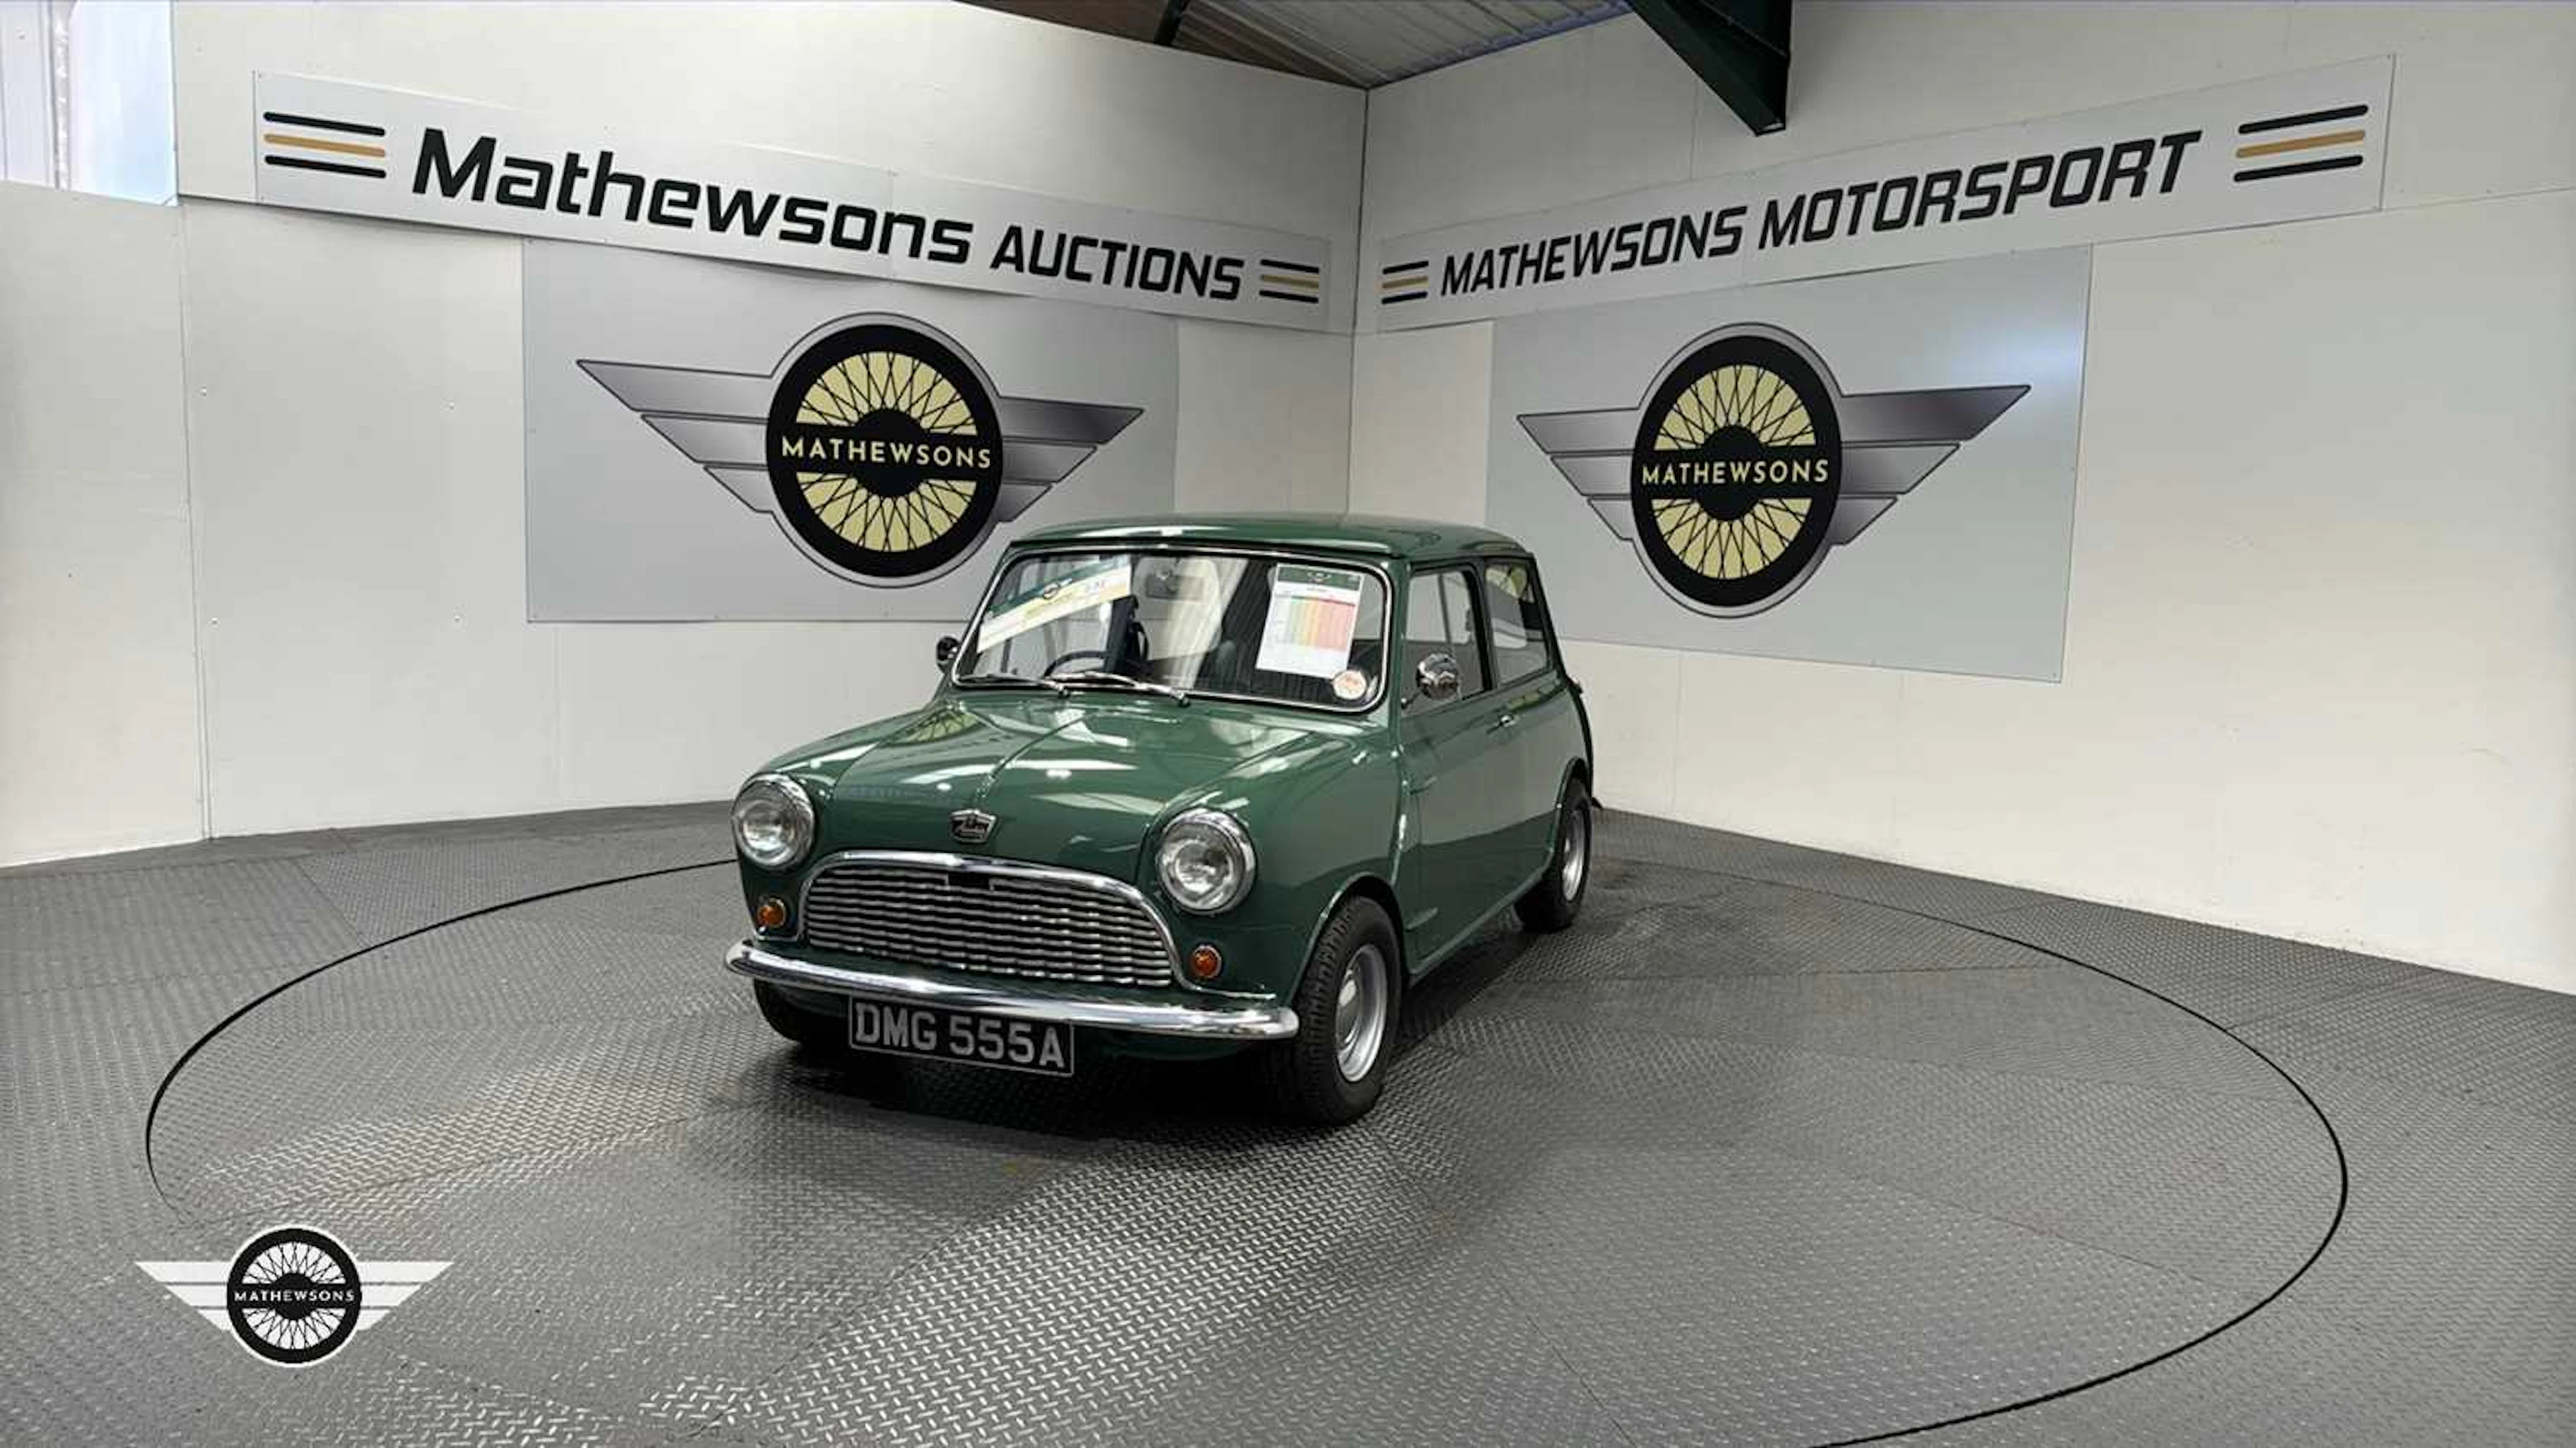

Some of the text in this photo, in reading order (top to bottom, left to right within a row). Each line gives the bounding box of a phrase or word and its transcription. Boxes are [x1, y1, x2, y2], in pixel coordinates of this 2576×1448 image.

[412, 127, 1245, 301] Mathewsons AUCTIONS
[1440, 130, 2203, 297] MATHEWSONS MOTORSPORT
[781, 435, 991, 469] MATHEWSONS
[1642, 458, 1829, 485] MATHEWSONS
[855, 1002, 1065, 1068] DMG 555A
